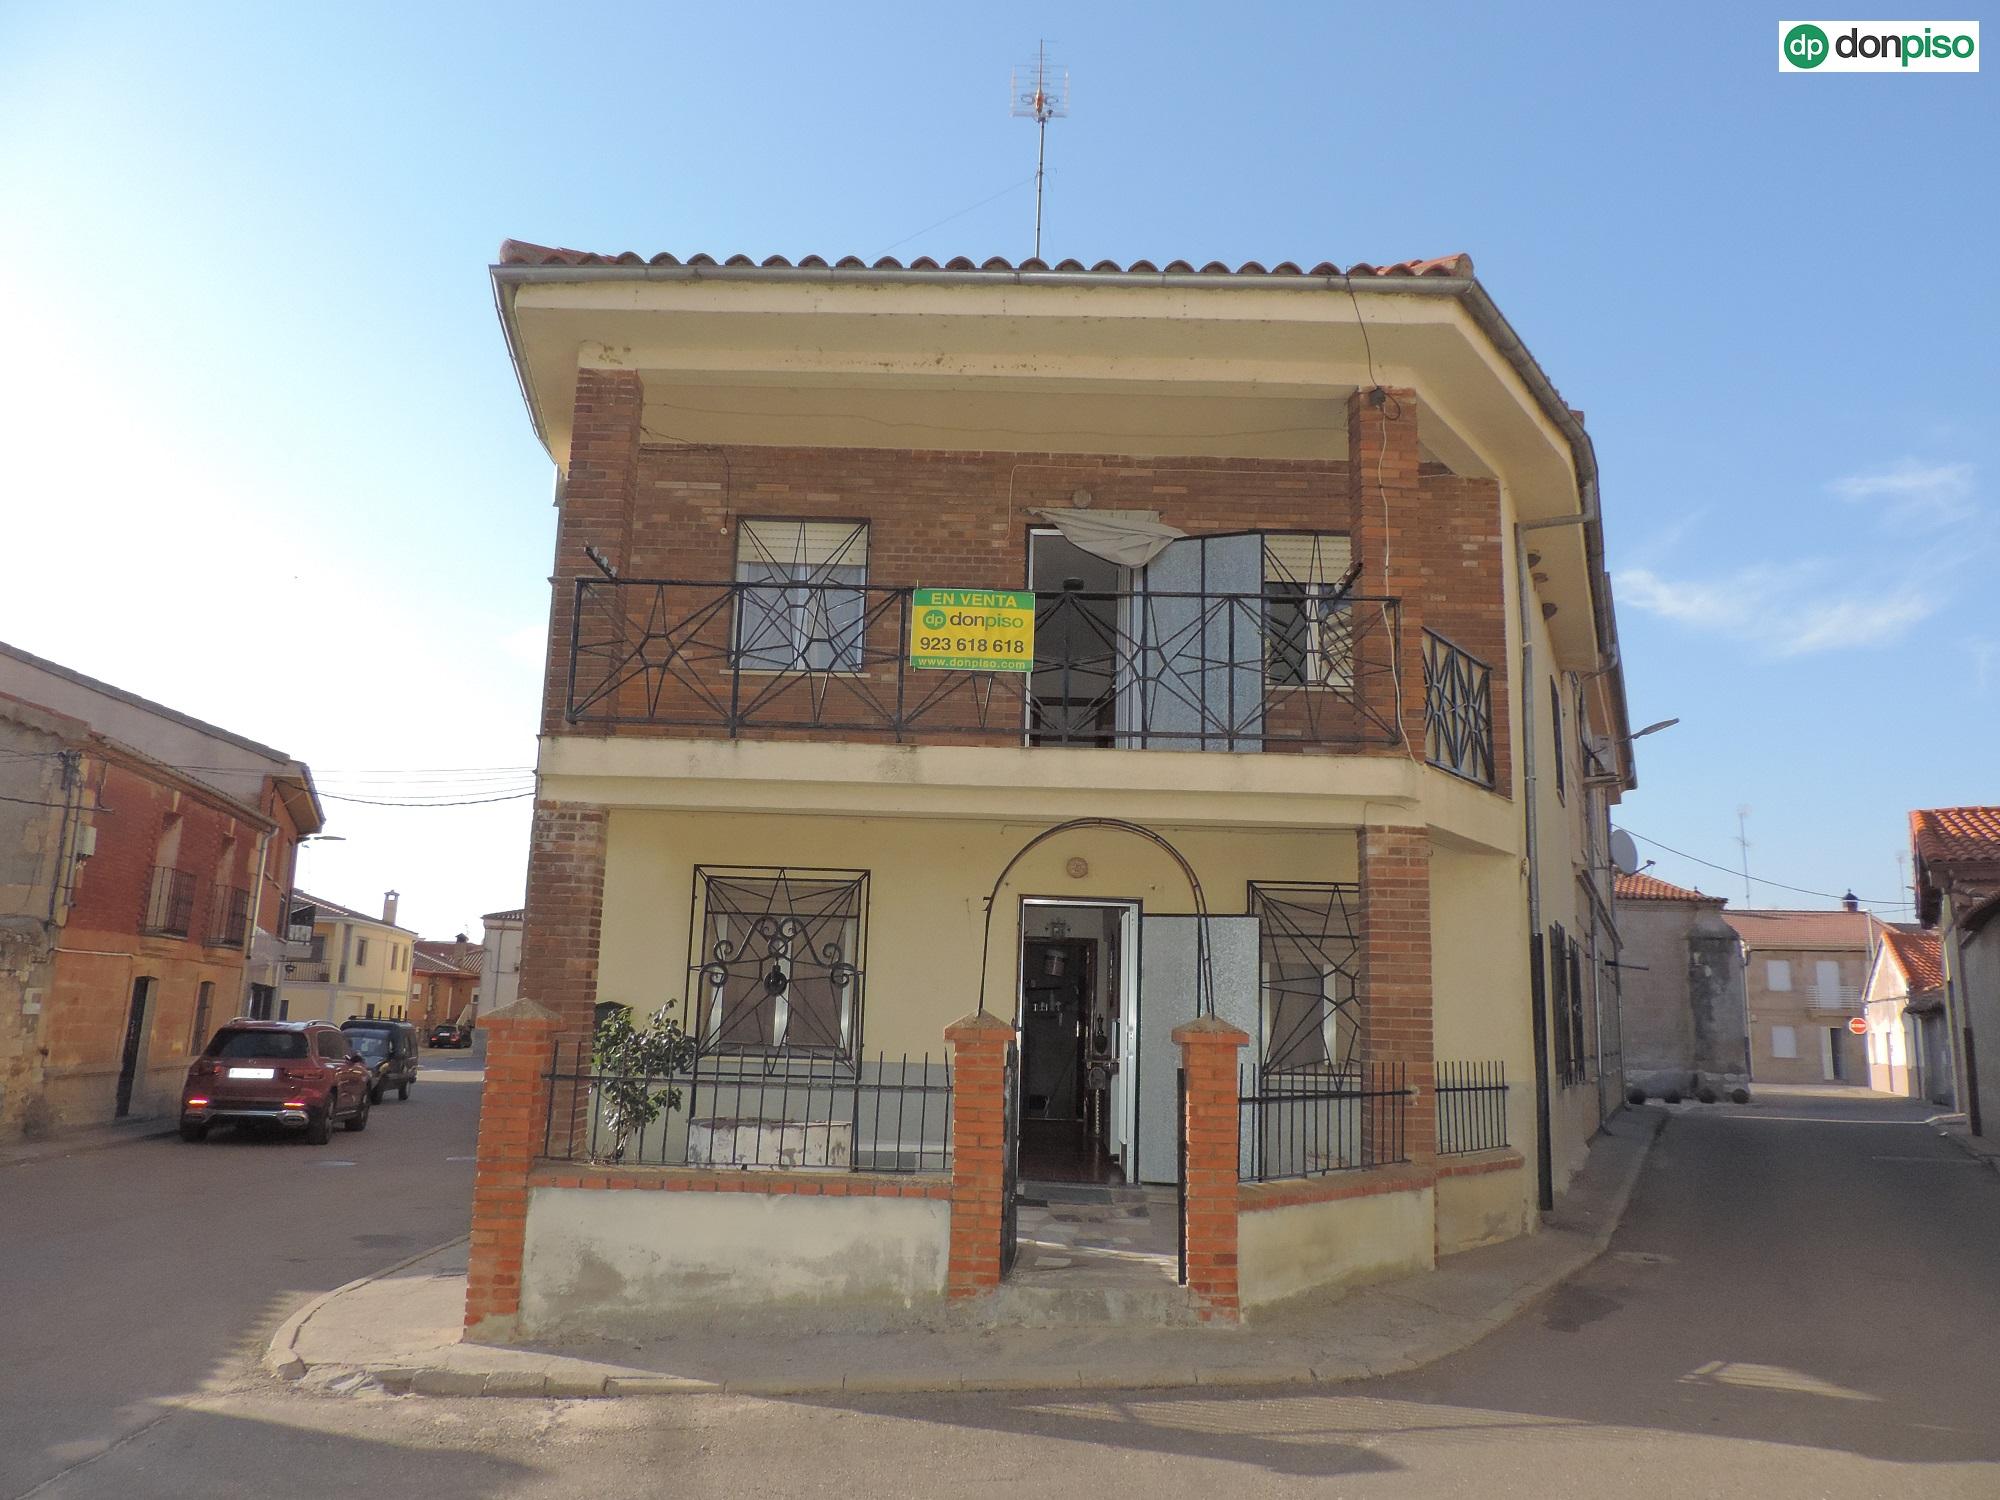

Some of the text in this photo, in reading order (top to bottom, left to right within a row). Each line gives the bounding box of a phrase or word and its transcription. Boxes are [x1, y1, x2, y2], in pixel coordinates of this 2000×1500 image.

[931, 592, 1017, 607] EN VENTA
[925, 611, 1024, 631] dp donpiso
[920, 636, 1024, 654] 923 618 618
[918, 657, 1025, 669] www.donpiso.com
